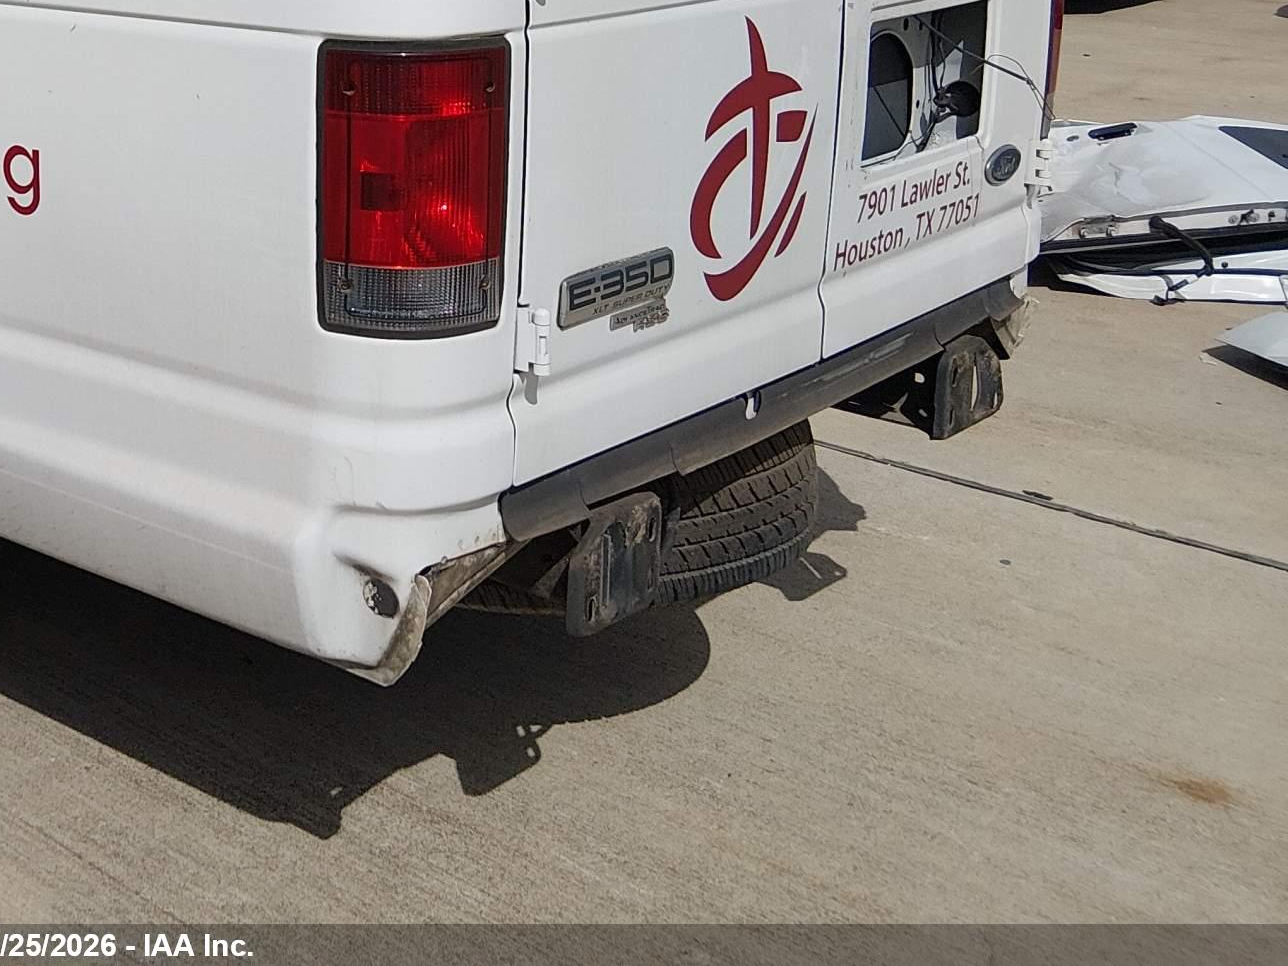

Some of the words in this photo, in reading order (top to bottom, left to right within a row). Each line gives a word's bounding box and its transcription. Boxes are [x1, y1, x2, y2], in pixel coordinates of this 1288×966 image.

[857, 184, 896, 224] 7901
[900, 169, 952, 208] Lawler
[954, 160, 971, 187] St.
[937, 192, 980, 233] 77051
[592, 303, 610, 315] XLT
[612, 292, 643, 309] SUPER
[644, 283, 671, 299] DUTY
